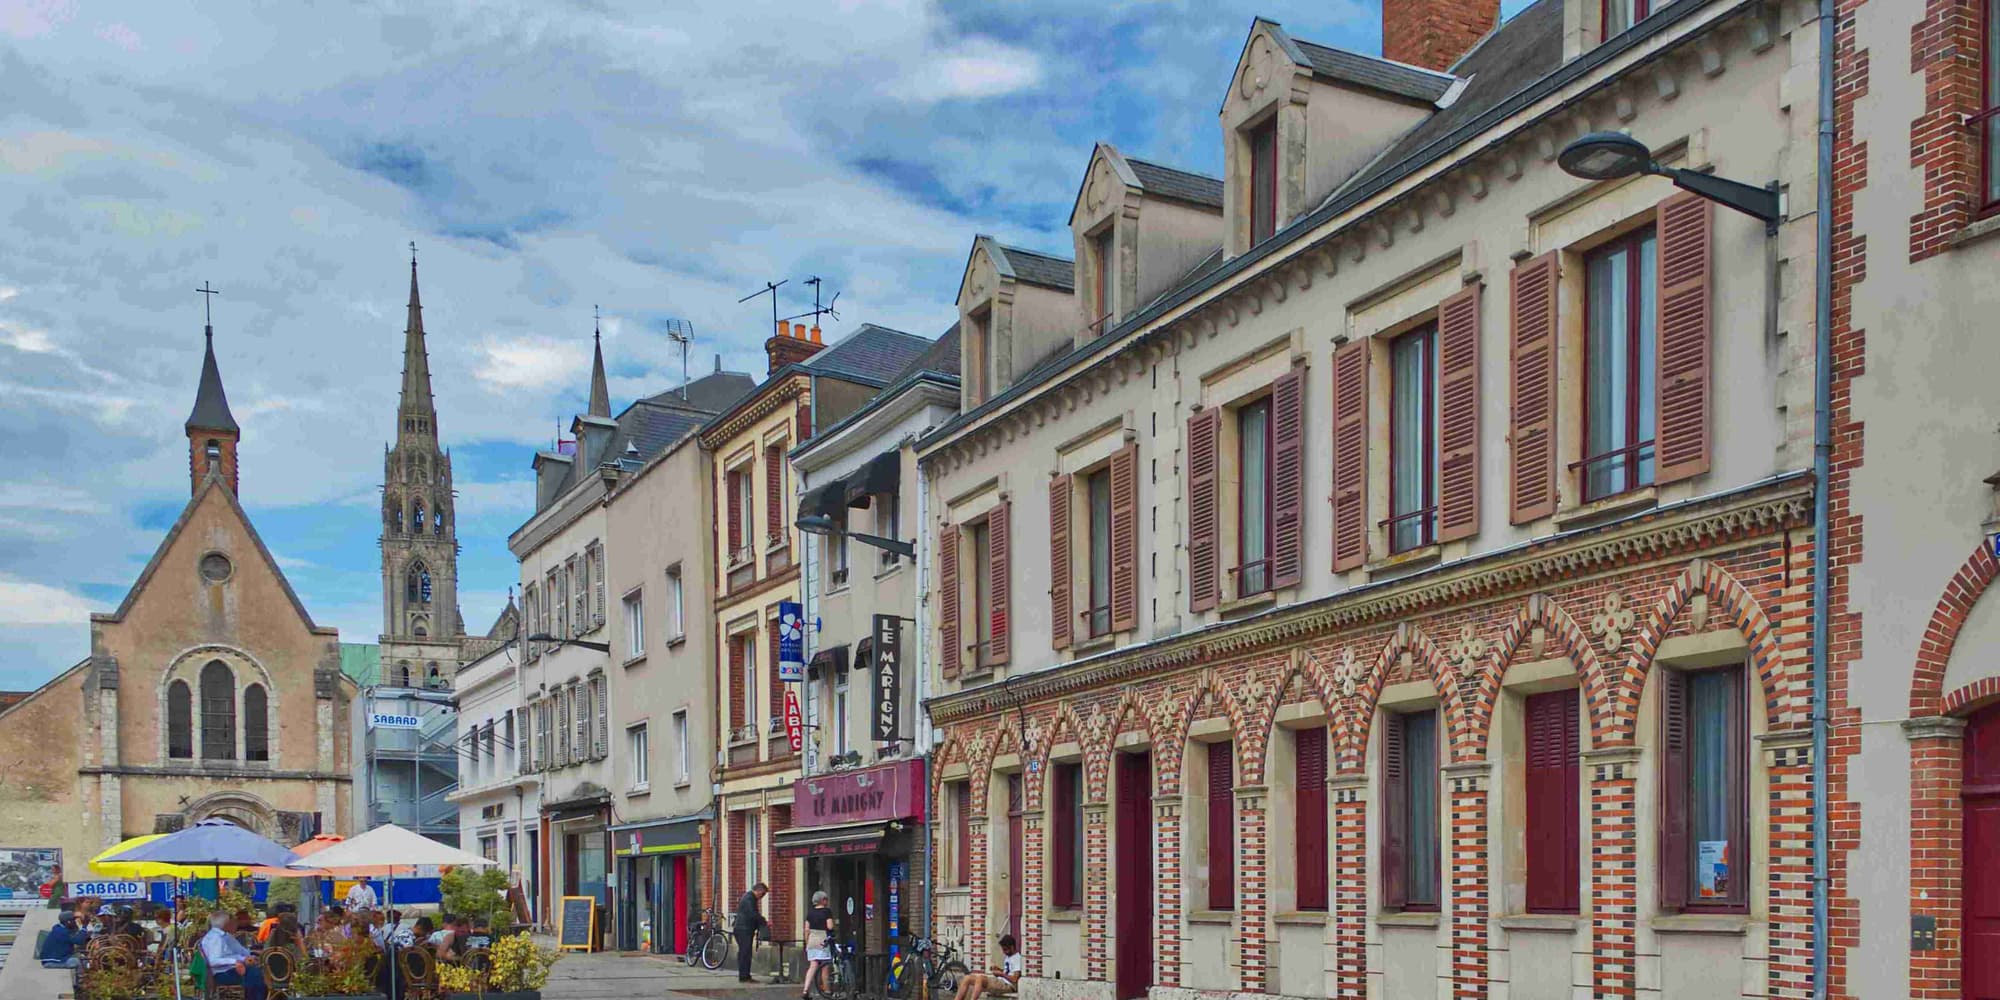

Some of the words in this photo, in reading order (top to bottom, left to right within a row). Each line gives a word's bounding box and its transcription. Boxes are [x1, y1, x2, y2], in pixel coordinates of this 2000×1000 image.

[882, 619, 893, 644] LE
[880, 651, 894, 737] MARIGNY
[373, 714, 418, 726] SABARD
[787, 693, 801, 748] TABAC
[813, 798, 825, 817] LE
[831, 791, 884, 814] MARIGNY
[76, 882, 138, 895] SABARD
